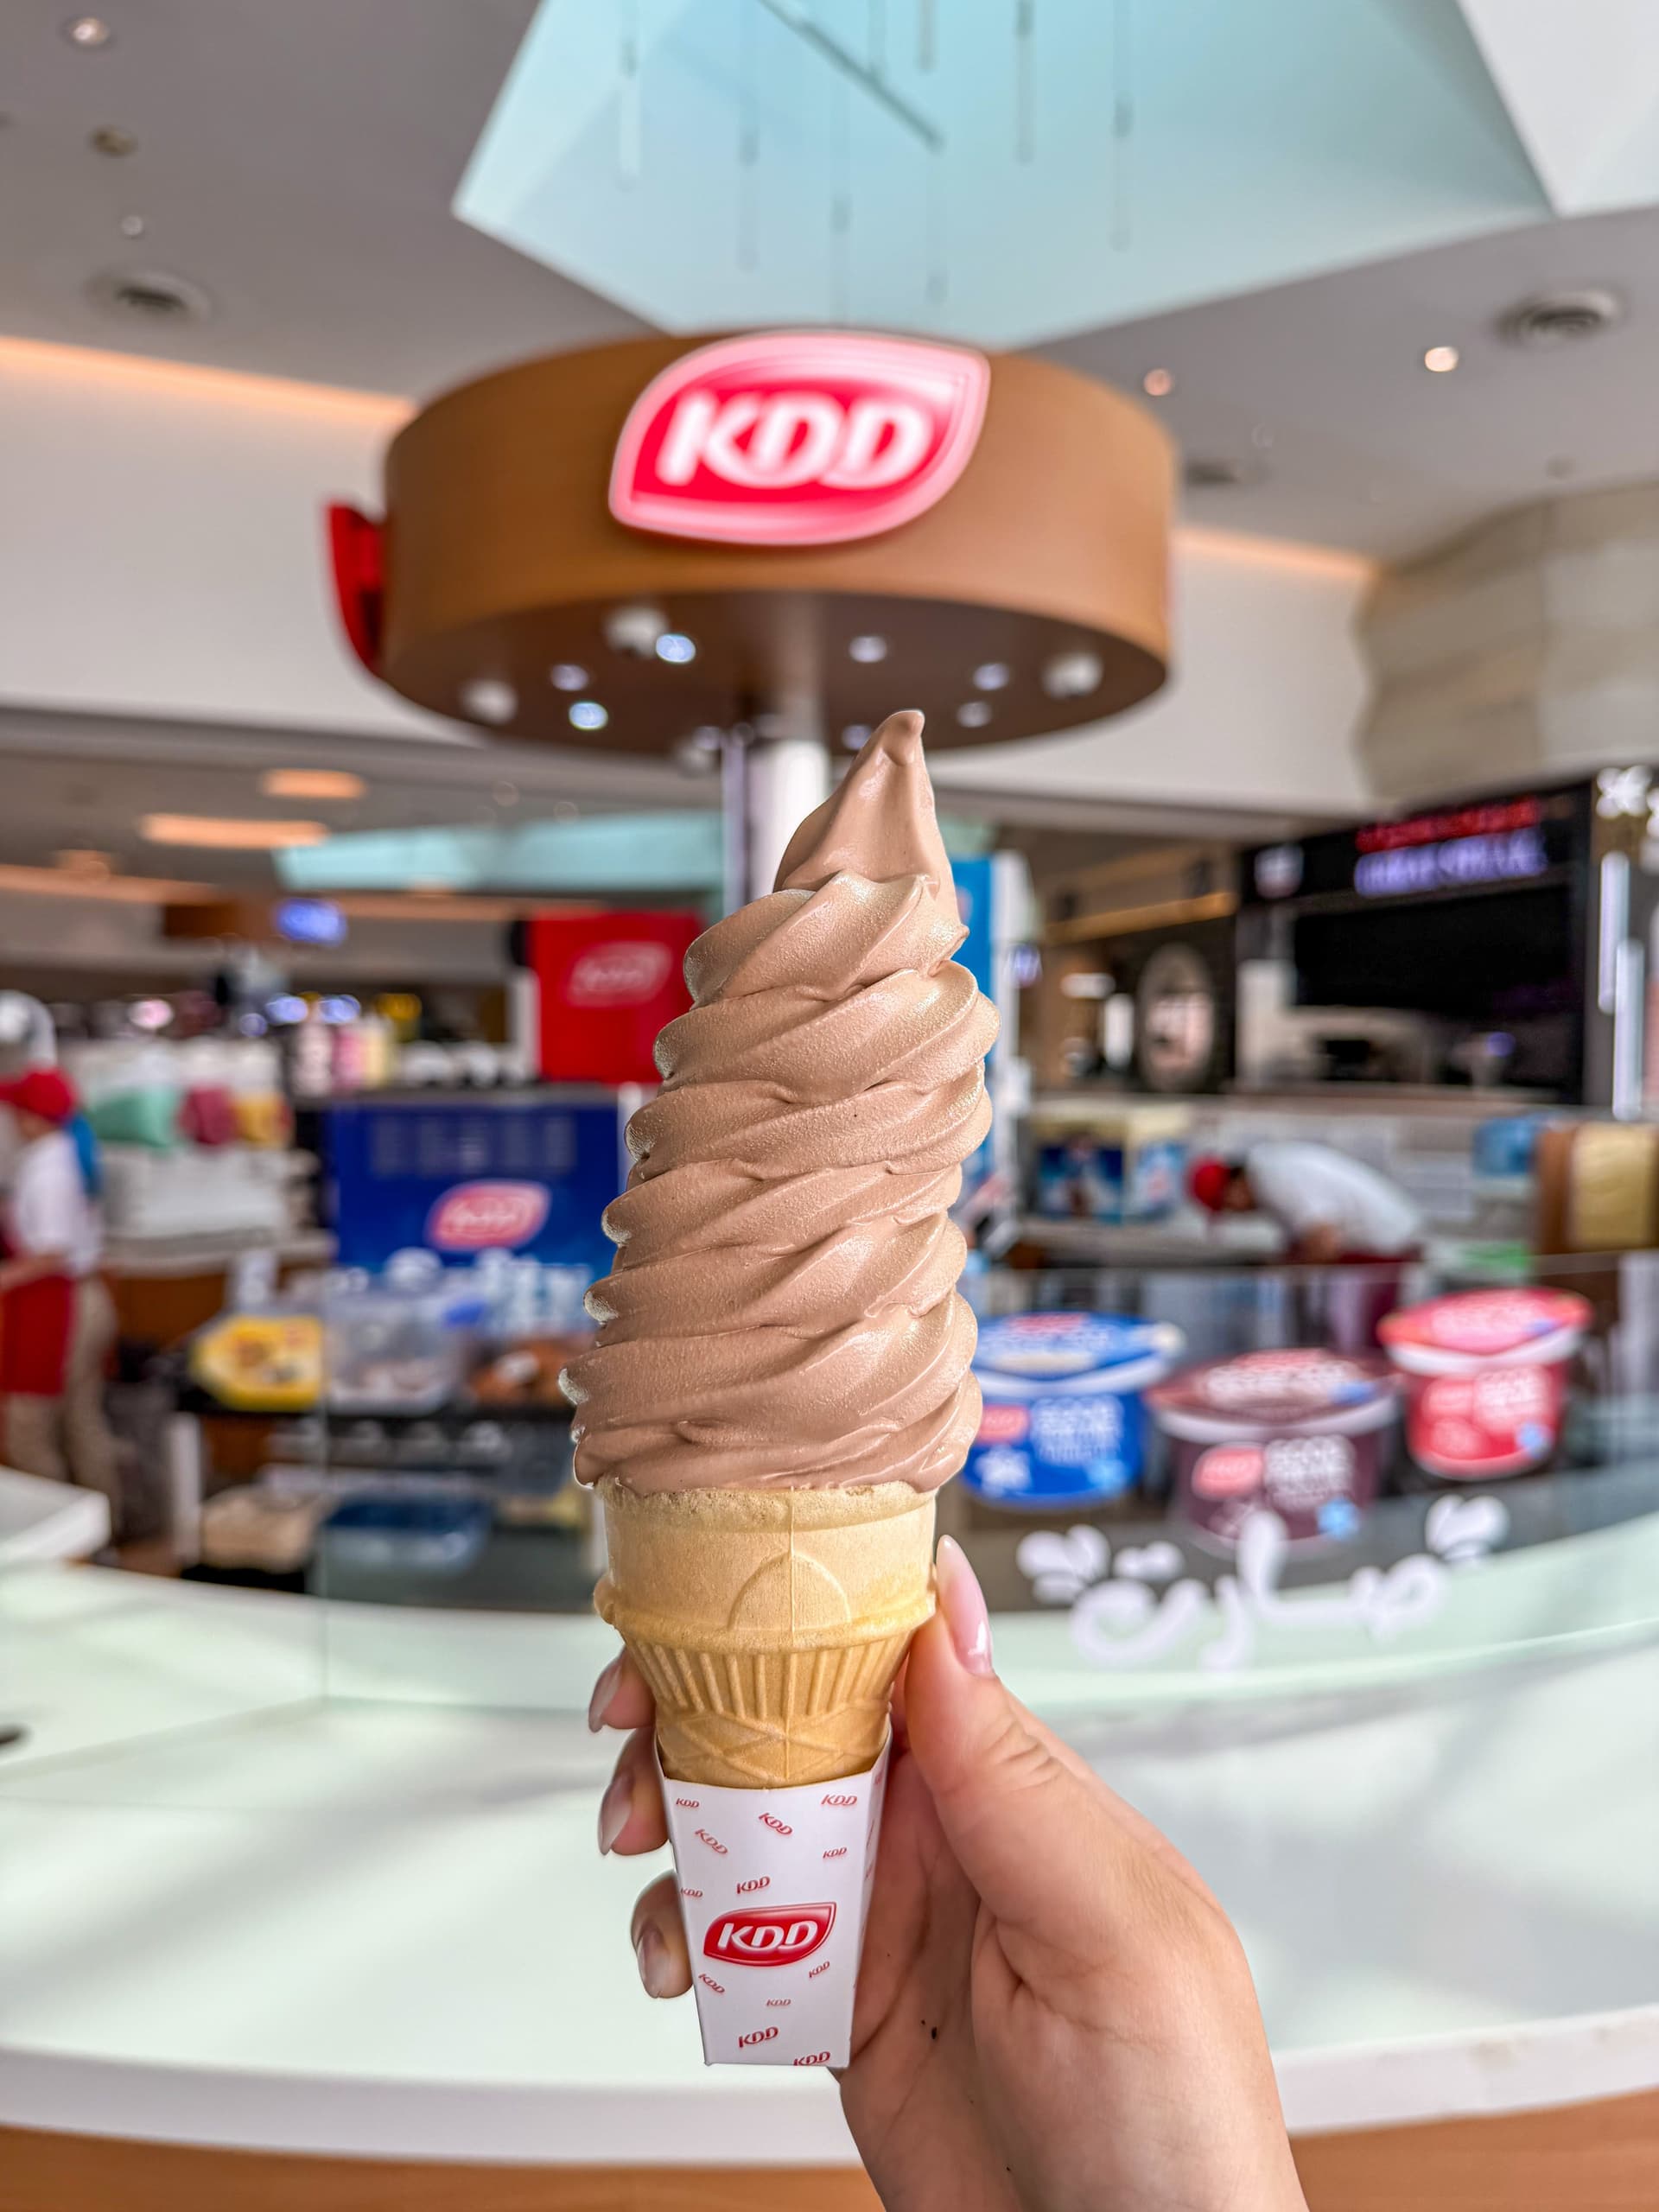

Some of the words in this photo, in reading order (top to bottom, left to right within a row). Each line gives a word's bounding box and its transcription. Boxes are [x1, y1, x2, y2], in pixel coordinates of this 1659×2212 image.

[657, 389, 931, 490] KDD
[676, 1798, 699, 1808] KDD
[821, 1795, 857, 1806] KDD
[759, 1813, 792, 1835] KDD
[695, 1829, 728, 1854] KDD
[823, 1847, 847, 1858] KDD
[681, 1887, 703, 1897] KDD
[737, 1876, 771, 1894] KDD
[717, 1920, 818, 1951] KDD
[809, 1961, 830, 1978] KDD
[698, 1974, 725, 1993] KDD
[739, 2026, 779, 2048] KDD
[793, 2051, 830, 2066] KDD
